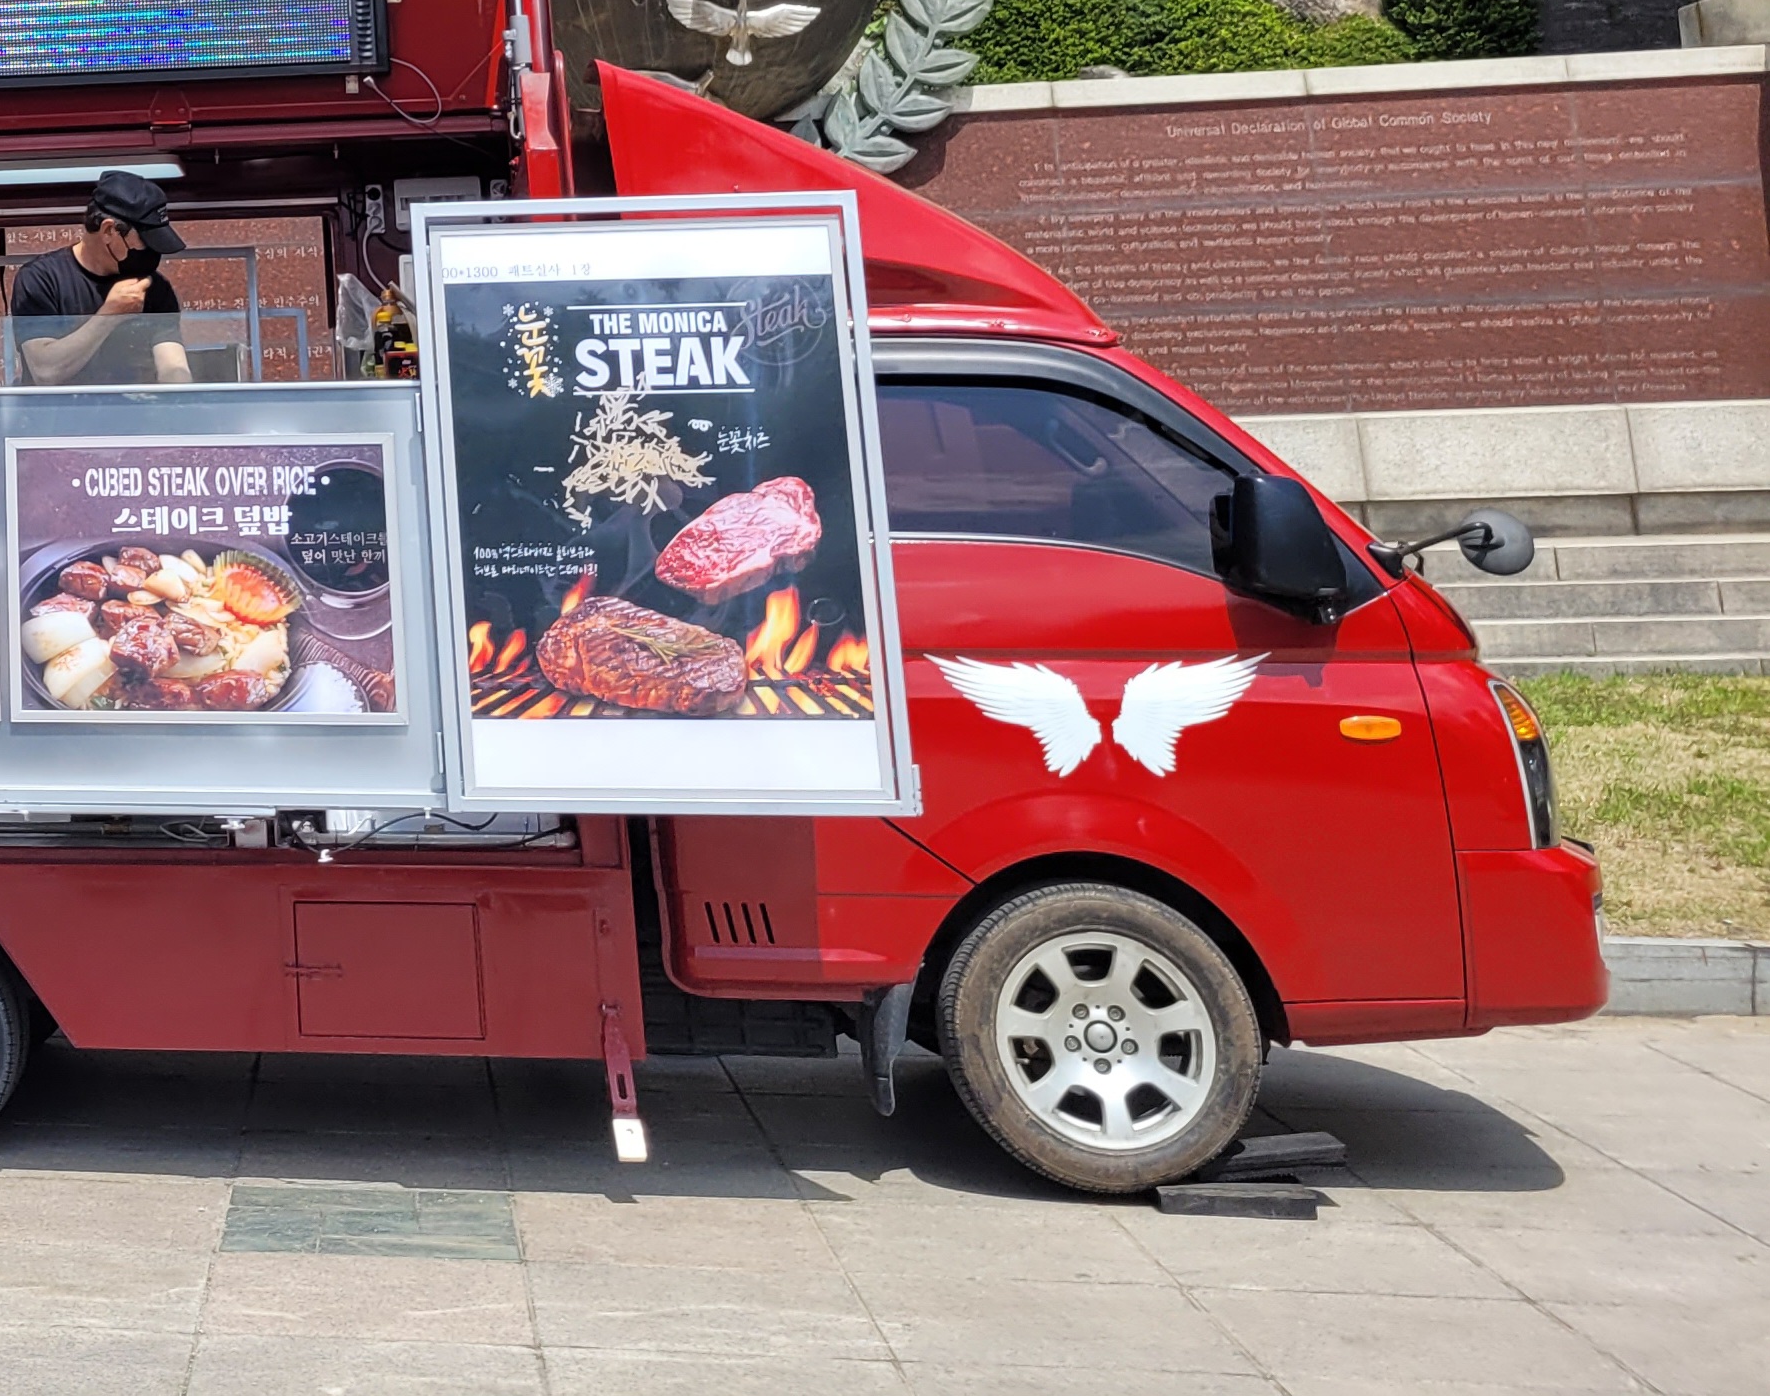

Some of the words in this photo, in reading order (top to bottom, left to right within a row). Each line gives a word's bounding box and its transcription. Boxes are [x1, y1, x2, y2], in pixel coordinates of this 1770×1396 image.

[1165, 122, 1225, 137] Universal
[1230, 118, 1305, 134] Declaration
[1313, 117, 1325, 130] of
[1331, 115, 1373, 130] Global
[1379, 112, 1435, 127] Common
[1442, 109, 1493, 126] Society
[589, 313, 633, 335] THE
[638, 311, 728, 334] MONICA
[575, 336, 751, 388] STEAK
[84, 468, 142, 497] CUBED
[148, 467, 207, 497] STEAK
[215, 467, 268, 496] OVER
[272, 465, 316, 496] RICE
[112, 506, 228, 535] 스테이크
[234, 506, 293, 537] 덮밥
[302, 549, 326, 564] 덮어
[331, 549, 356, 564] 맛난
[361, 549, 385, 564] 한끼
